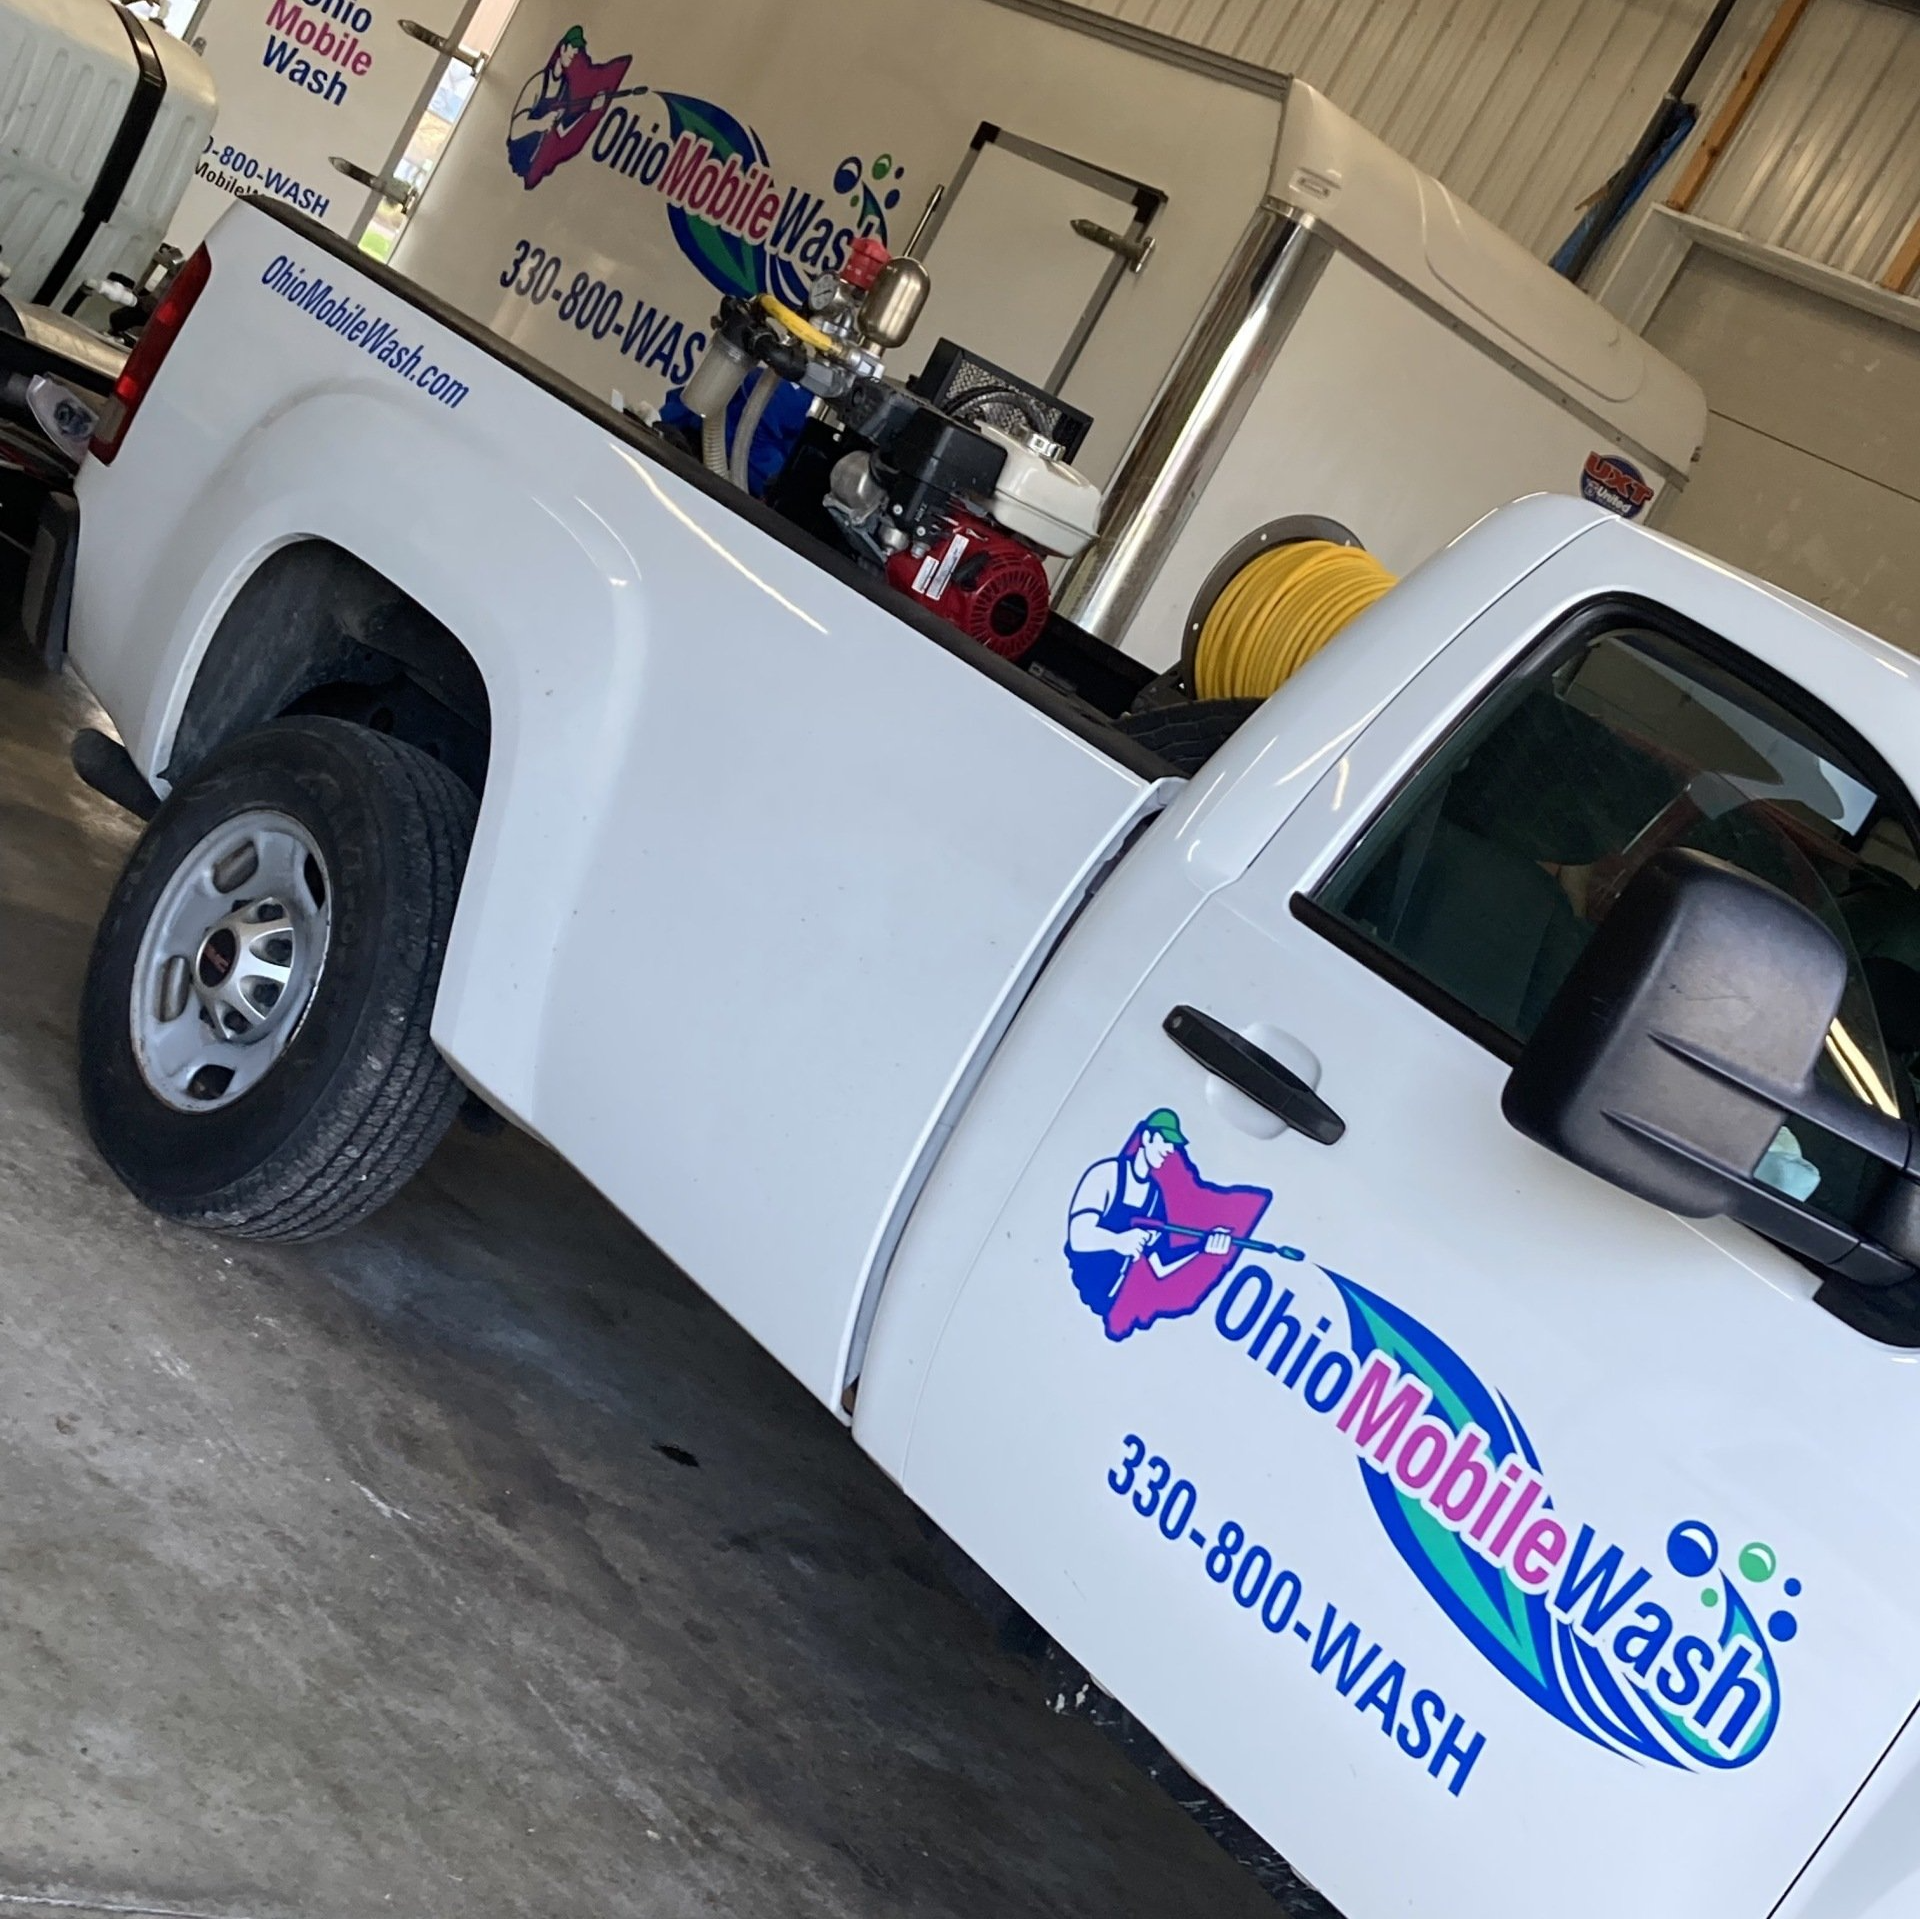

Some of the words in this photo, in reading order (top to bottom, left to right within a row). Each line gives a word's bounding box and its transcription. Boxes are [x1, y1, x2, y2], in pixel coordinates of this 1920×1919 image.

[262, 33, 348, 106] Wash
[265, 0, 372, 76] Mobile
[591, 106, 874, 272] OhioMobileWas
[261, 254, 470, 409] OhioMobileWash.com
[500, 238, 707, 386] 330-800-WAS
[1584, 450, 1655, 506] UXT
[1107, 1433, 1488, 1797] 330-800-WASH
